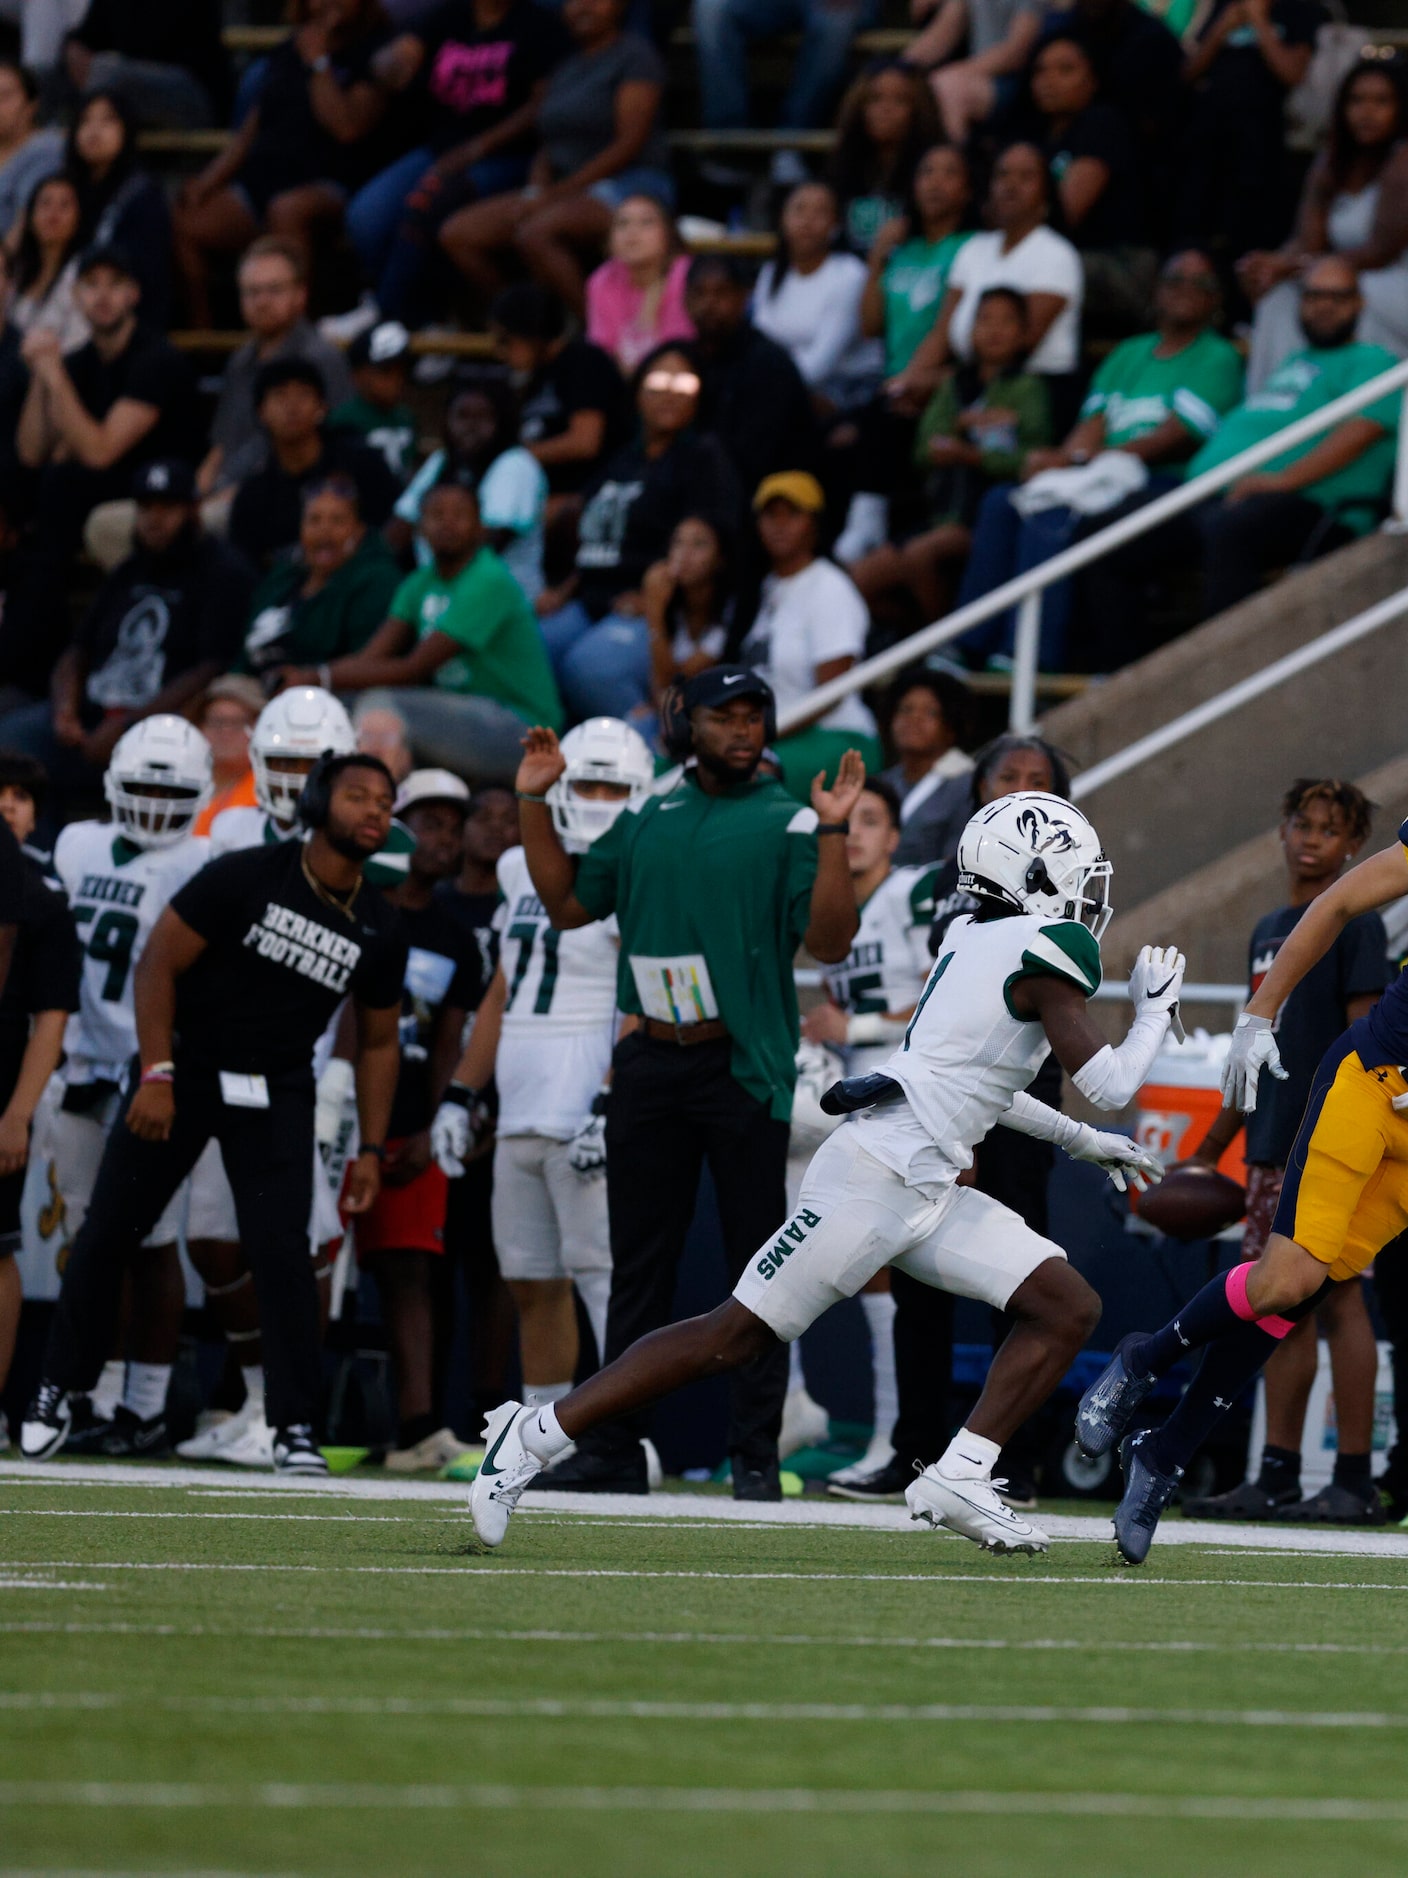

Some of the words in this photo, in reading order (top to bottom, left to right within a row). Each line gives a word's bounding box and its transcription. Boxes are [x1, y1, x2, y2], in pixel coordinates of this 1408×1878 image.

[242, 922, 351, 994] FOOTBALL
[261, 901, 362, 970] BERKNER
[756, 1208, 823, 1281] RAMS
